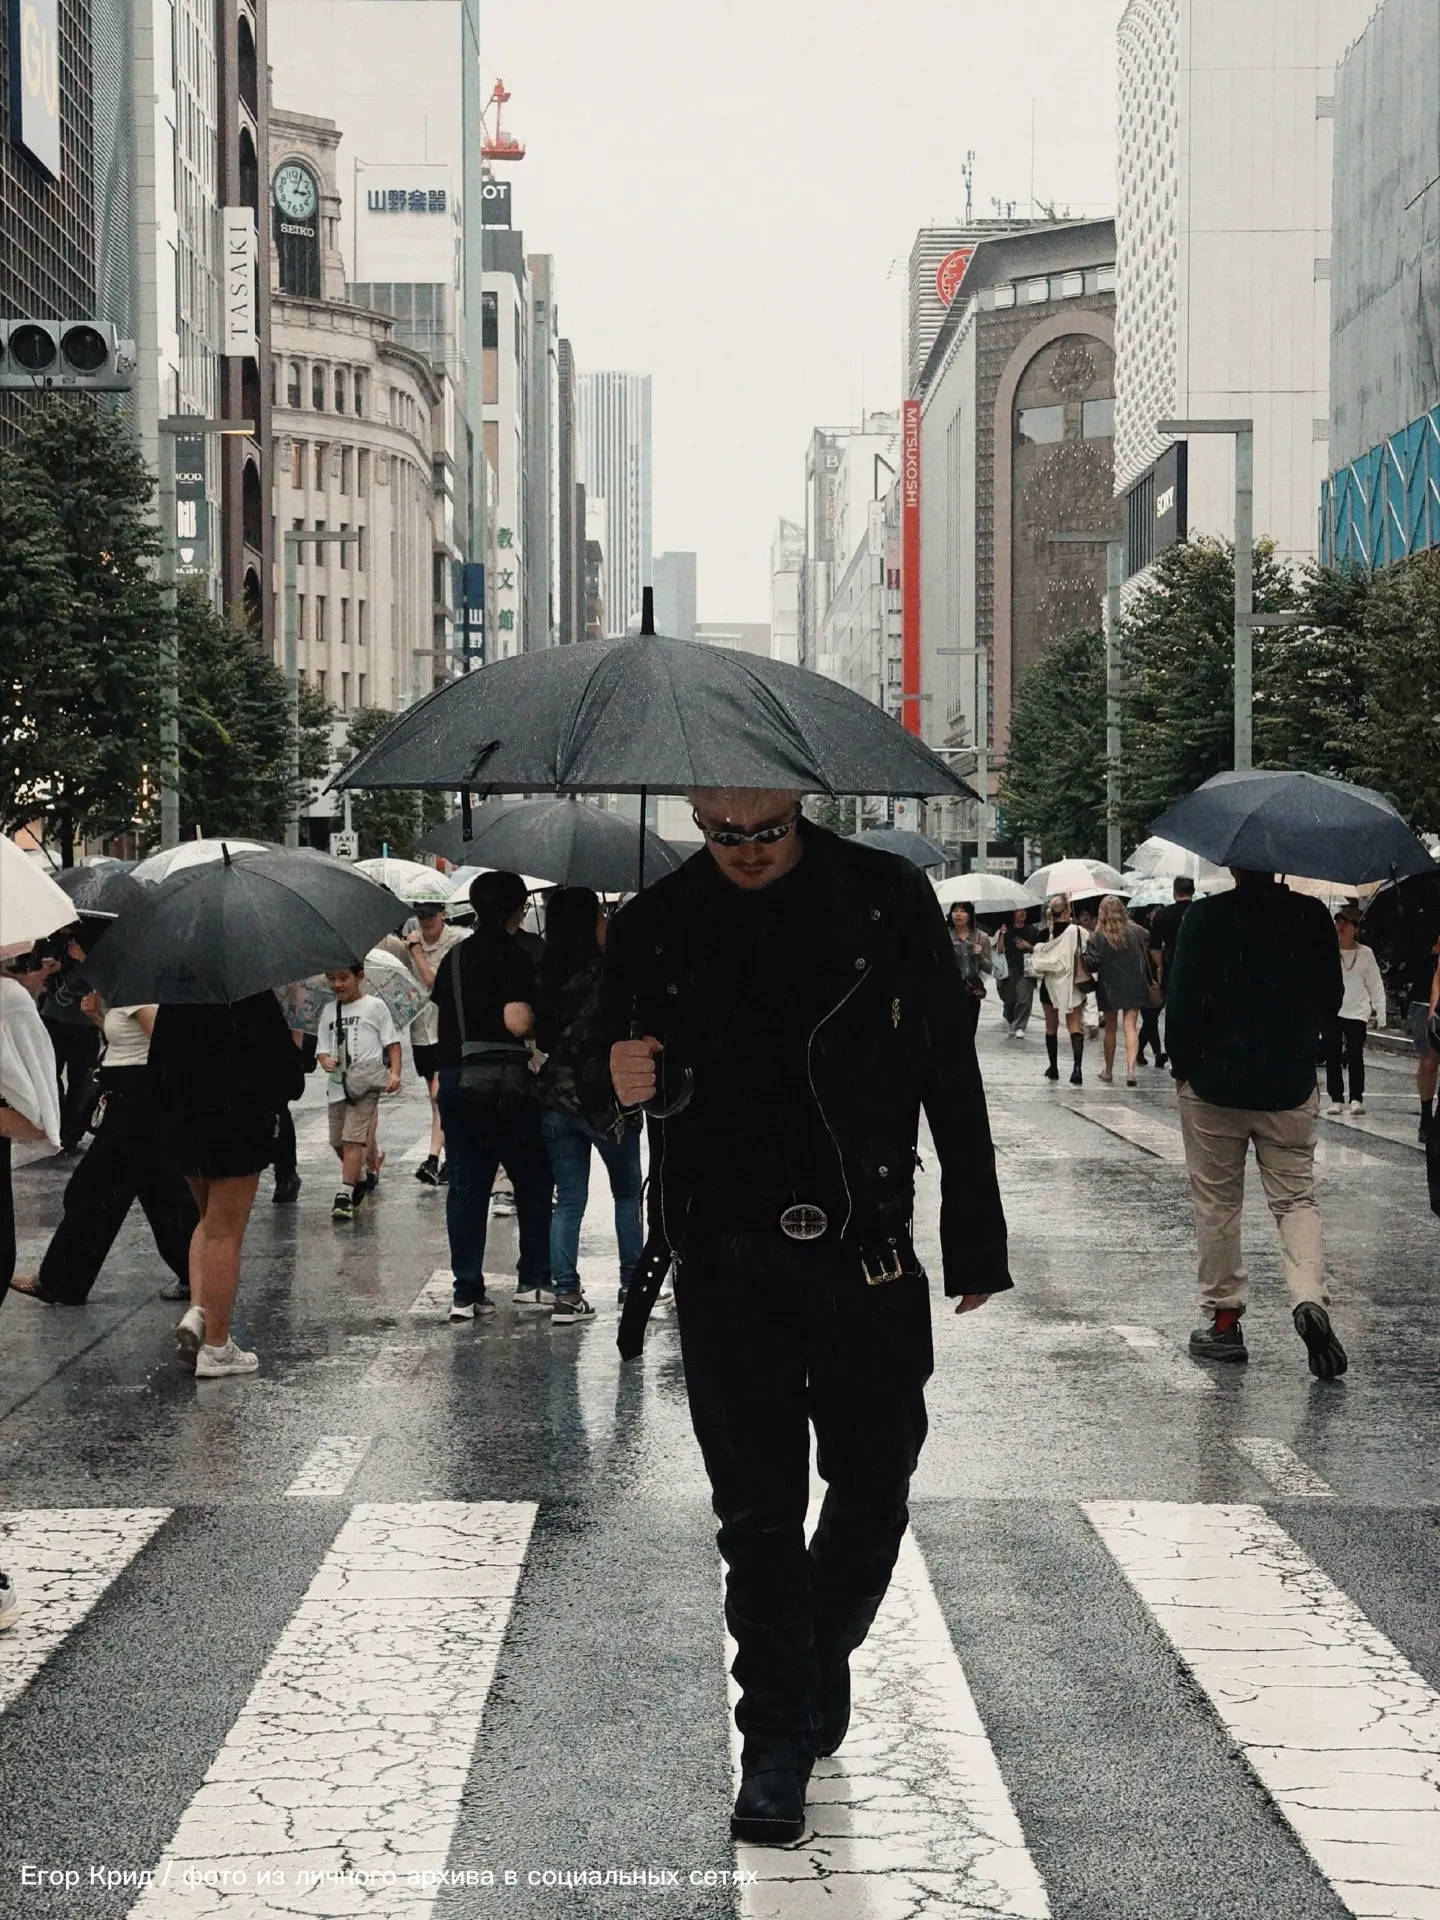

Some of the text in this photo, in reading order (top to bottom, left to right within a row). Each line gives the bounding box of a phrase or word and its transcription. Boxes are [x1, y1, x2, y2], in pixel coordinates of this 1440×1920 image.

[22, 5, 58, 117] GU
[368, 189, 447, 212] 山野楽器
[480, 184, 508, 200] OT
[280, 223, 315, 238] SEIKO
[230, 227, 248, 340] TASAKI
[905, 407, 917, 508] MITSUKOSHI
